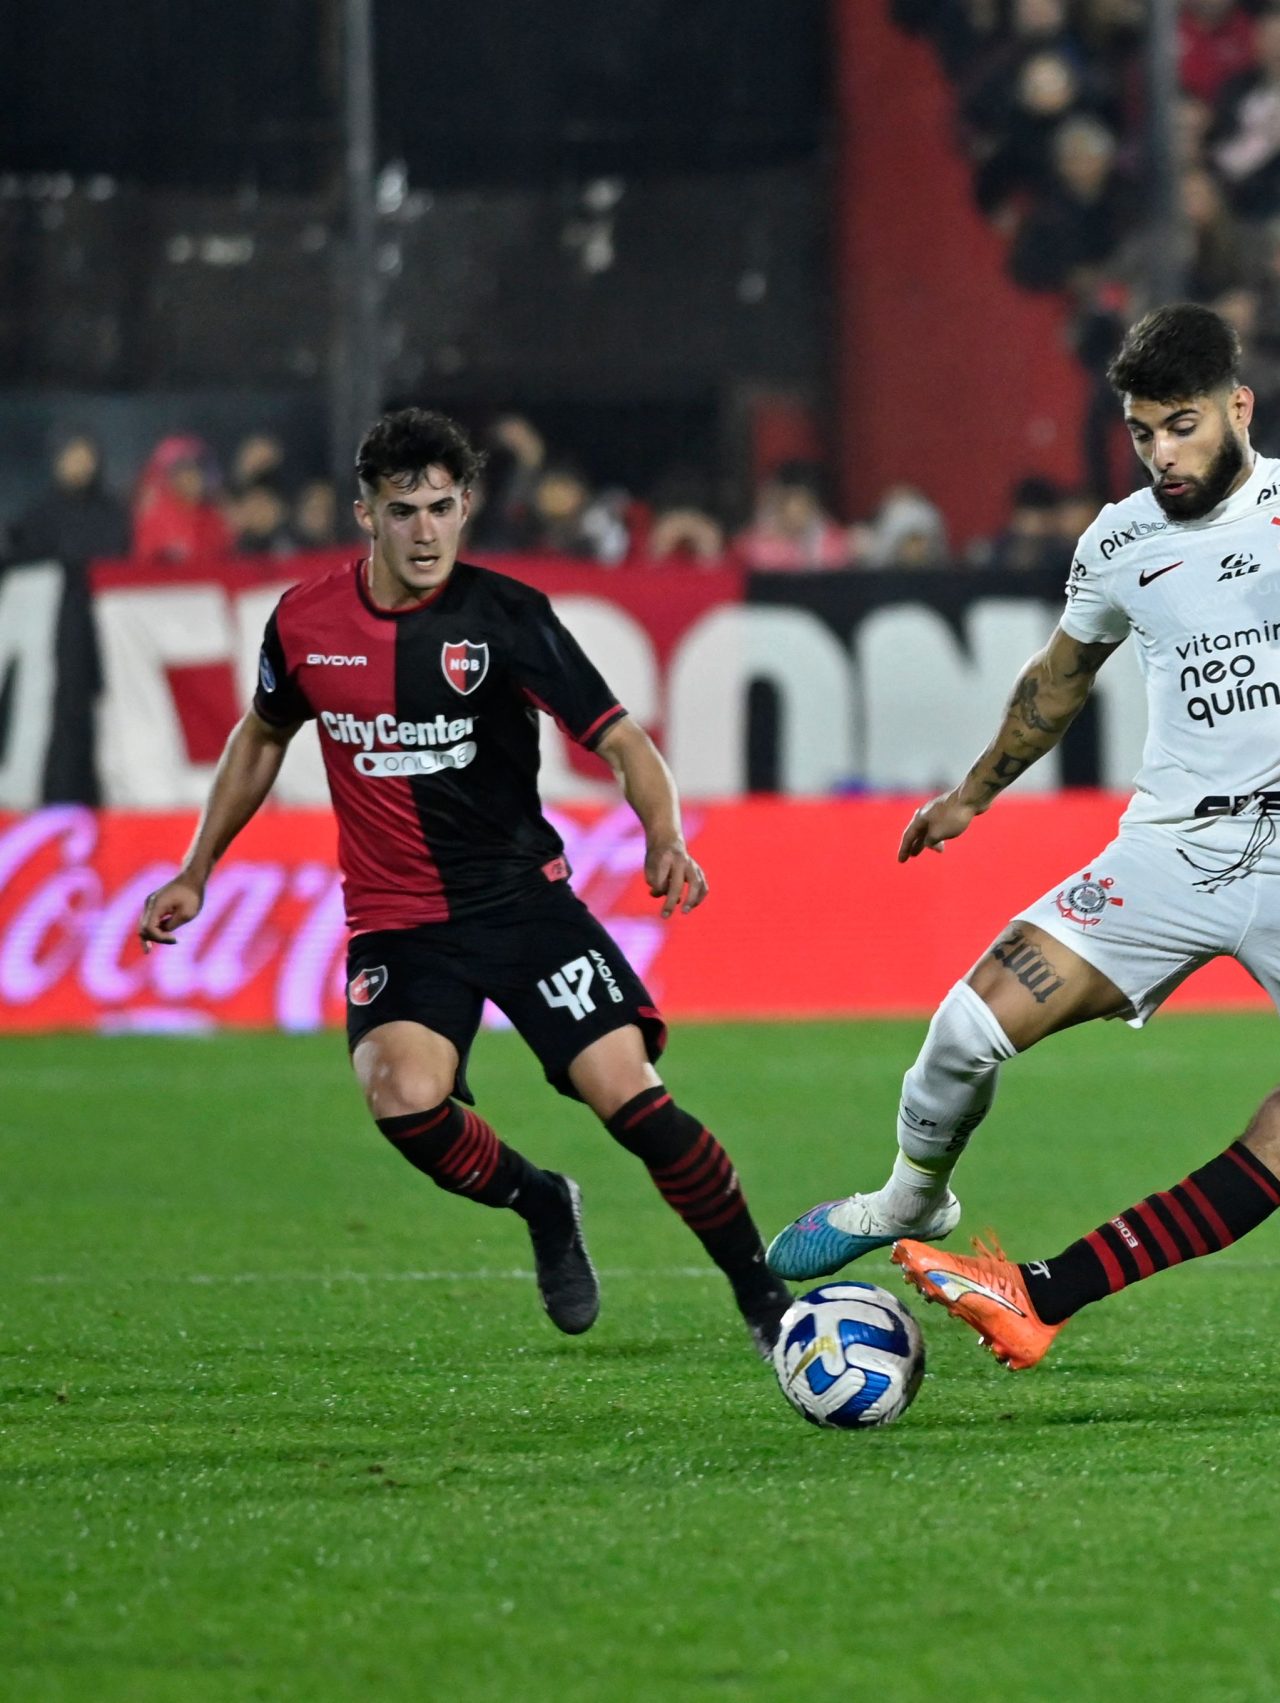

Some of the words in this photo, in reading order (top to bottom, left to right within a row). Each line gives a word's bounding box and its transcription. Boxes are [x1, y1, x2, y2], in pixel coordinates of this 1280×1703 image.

[1217, 563, 1261, 582] ALE
[306, 654, 368, 667] GIVOVA
[450, 659, 480, 671] NOB
[1180, 654, 1256, 692] neo
[537, 955, 597, 1021] 47
